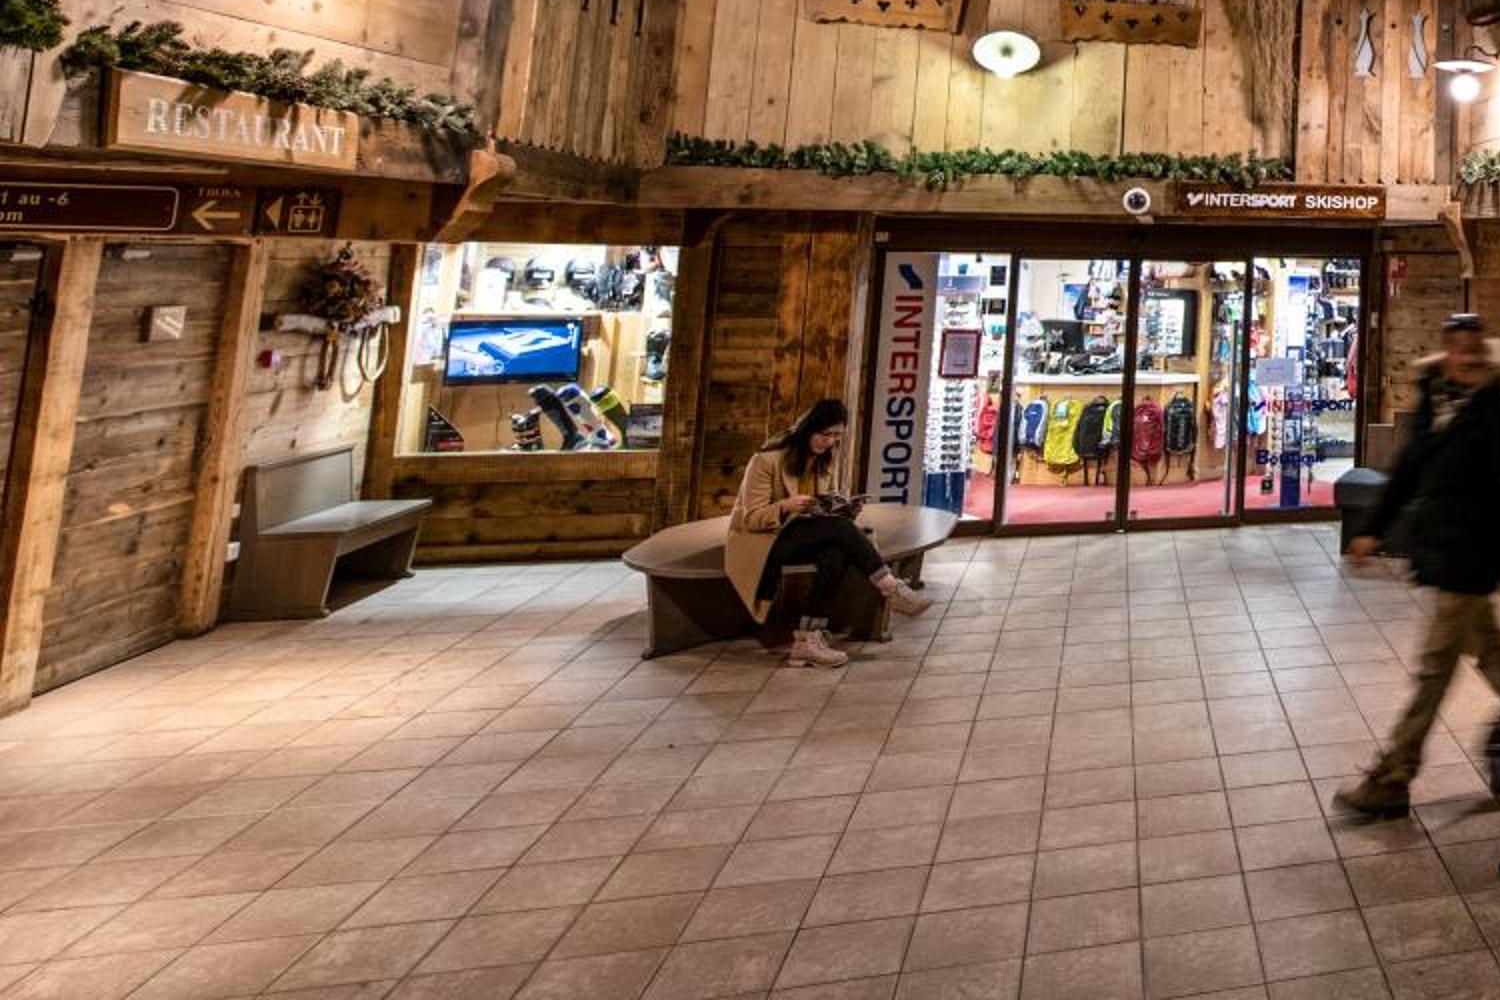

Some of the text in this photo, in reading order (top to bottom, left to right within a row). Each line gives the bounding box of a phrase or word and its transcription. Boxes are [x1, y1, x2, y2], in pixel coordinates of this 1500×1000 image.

[146, 98, 345, 156] RESTAURANT
[1205, 193, 1379, 209] INTERSPORT SKISHOP
[879, 295, 923, 505] INTERSPORT
